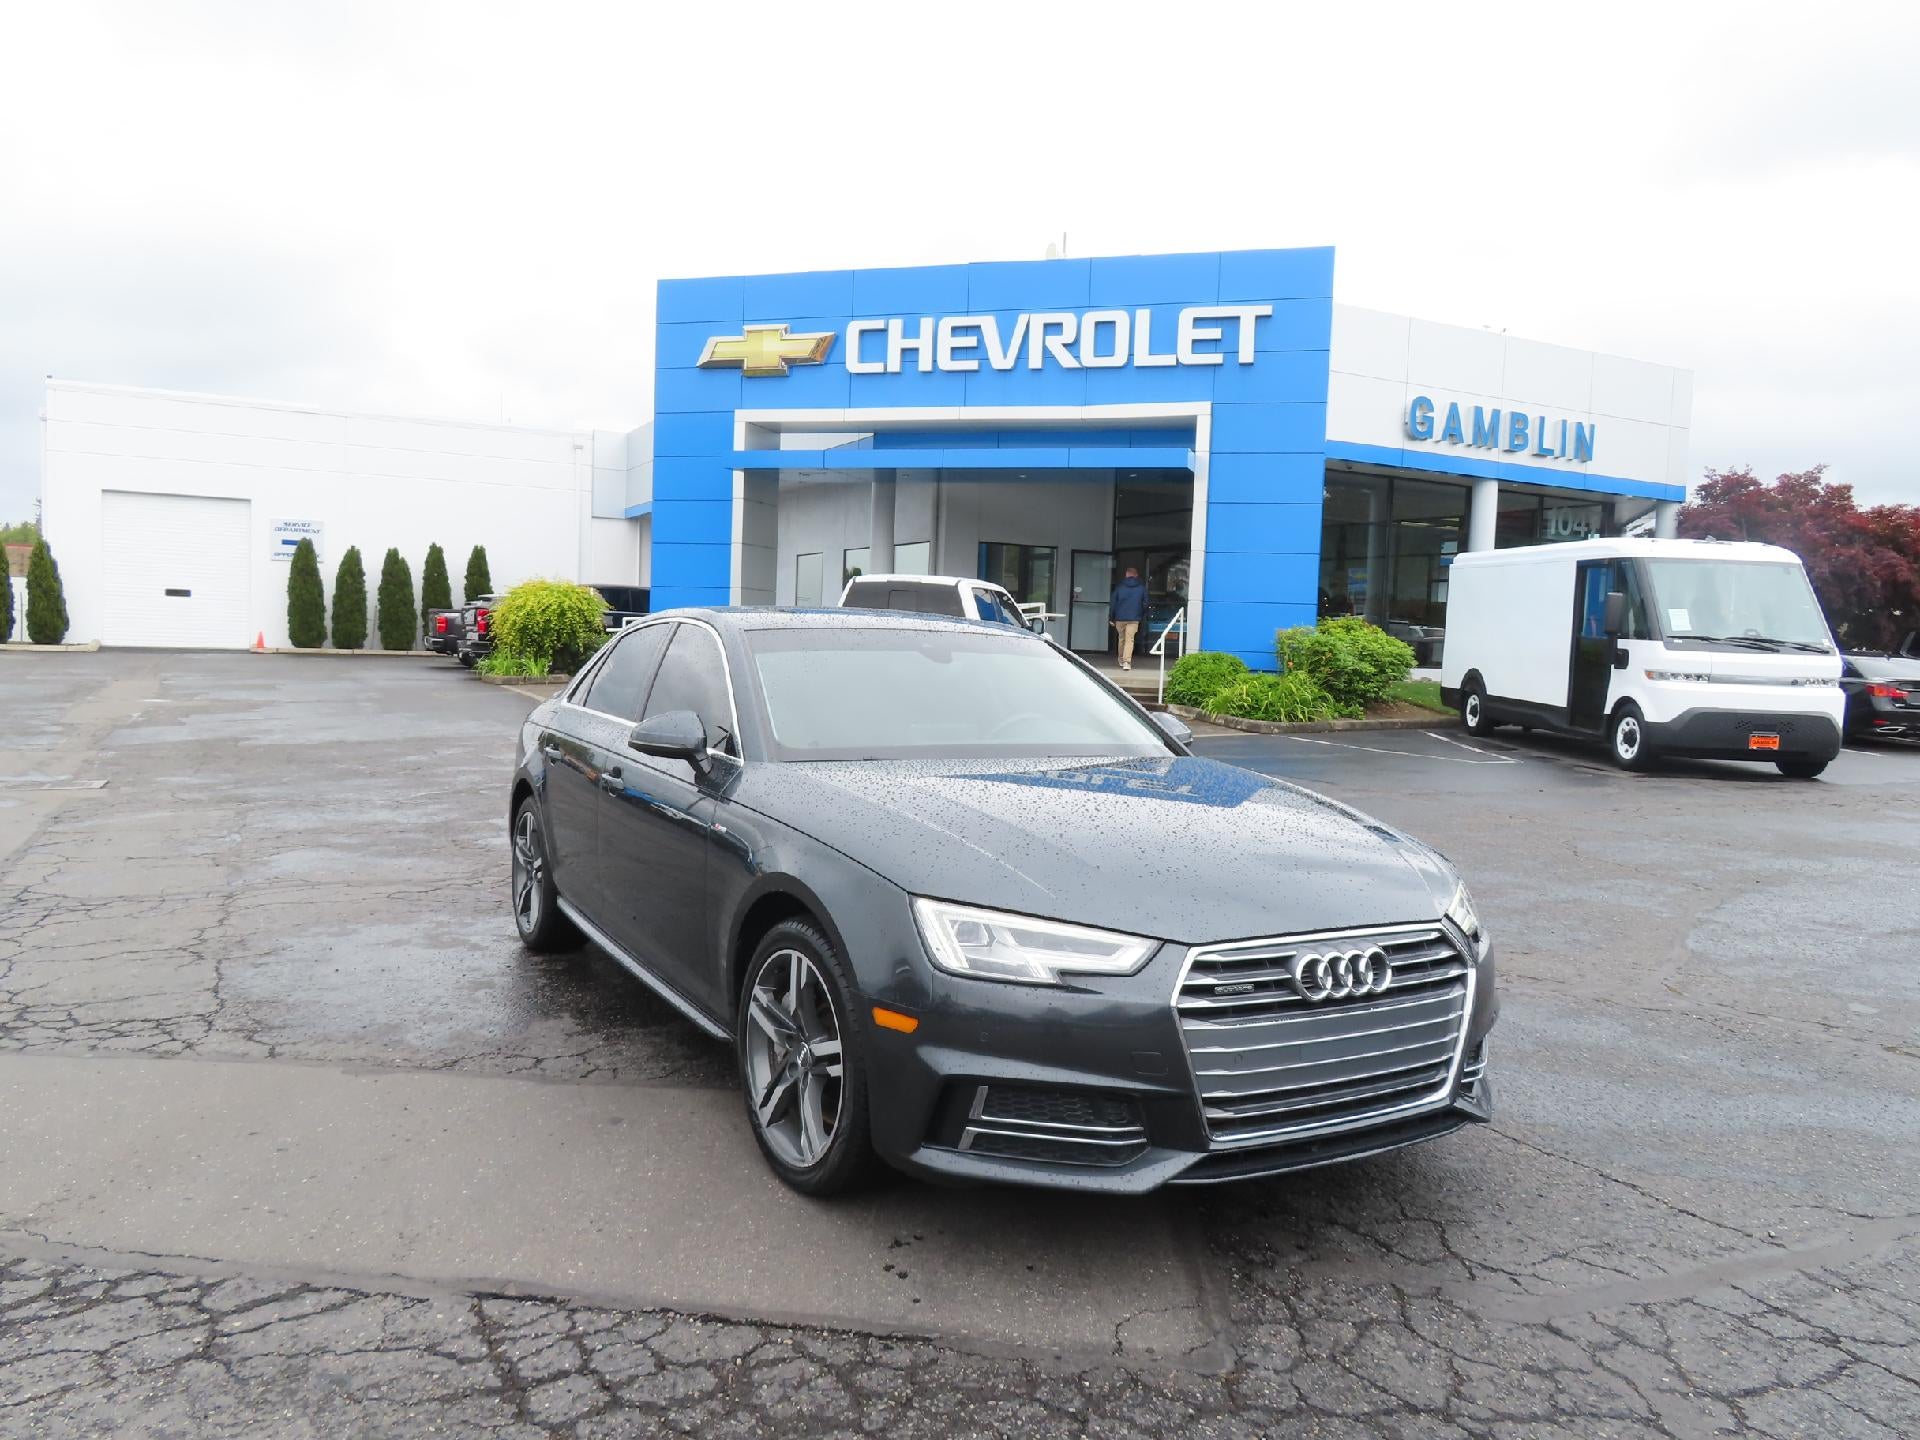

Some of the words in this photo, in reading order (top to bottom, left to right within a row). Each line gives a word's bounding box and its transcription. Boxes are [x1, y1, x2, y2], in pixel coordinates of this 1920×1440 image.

[845, 304, 1273, 374] CHEVROLET
[1407, 395, 1595, 463] GAMBLIN
[274, 526, 321, 534] DEPARTMENT
